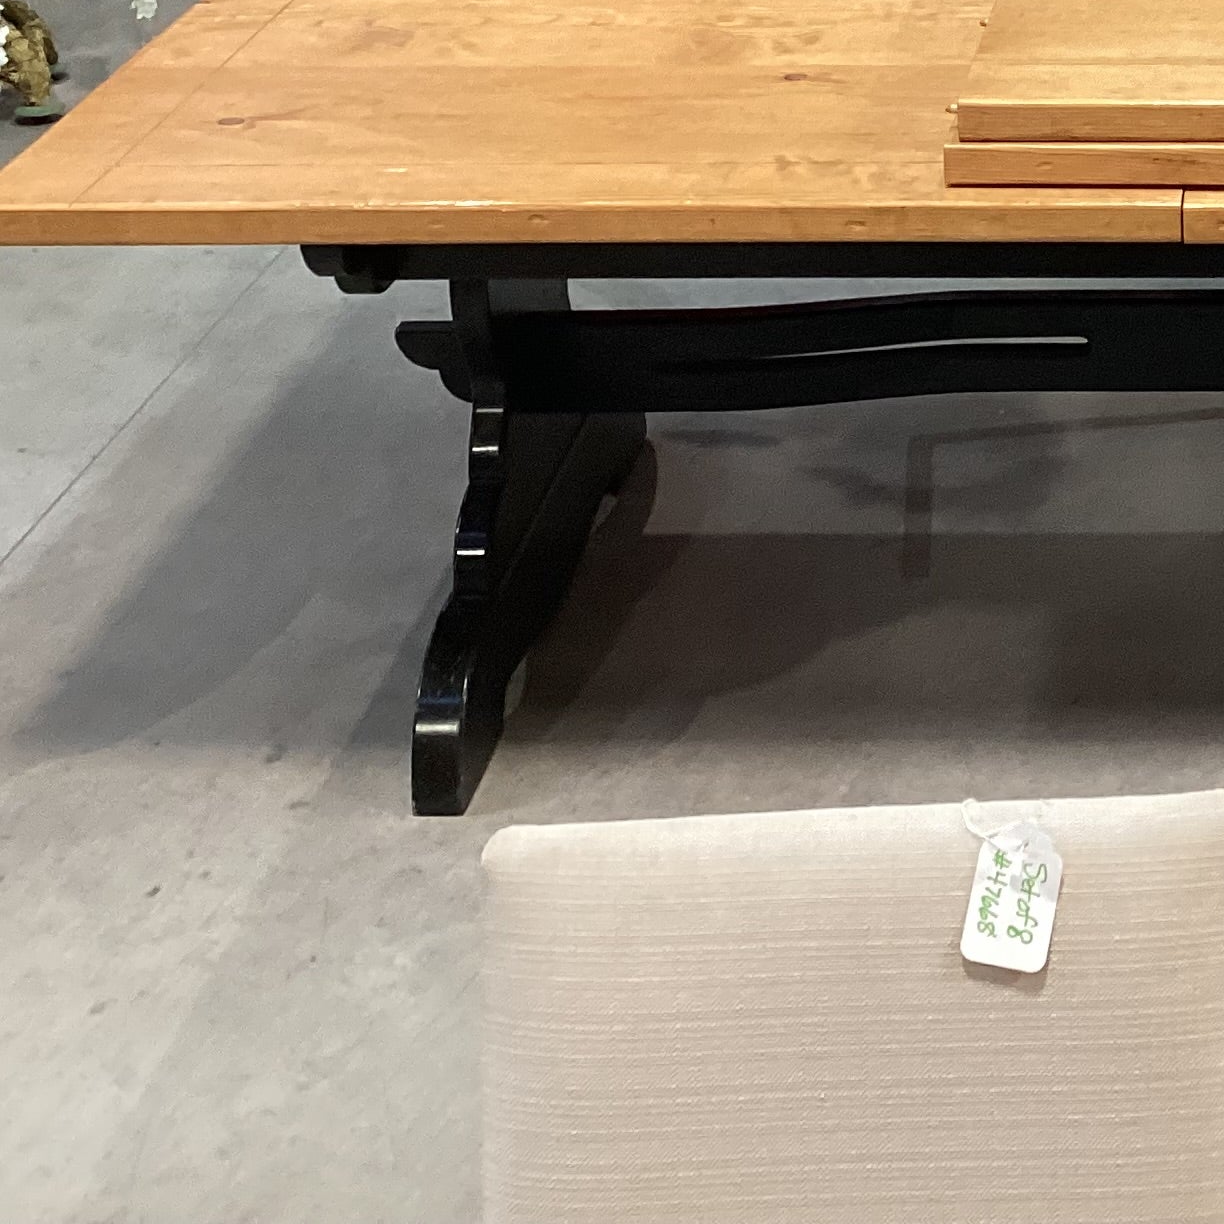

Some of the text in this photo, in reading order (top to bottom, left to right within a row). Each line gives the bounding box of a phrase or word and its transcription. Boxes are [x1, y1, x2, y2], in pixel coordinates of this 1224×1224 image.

[1006, 862, 1048, 945] Set of 8
